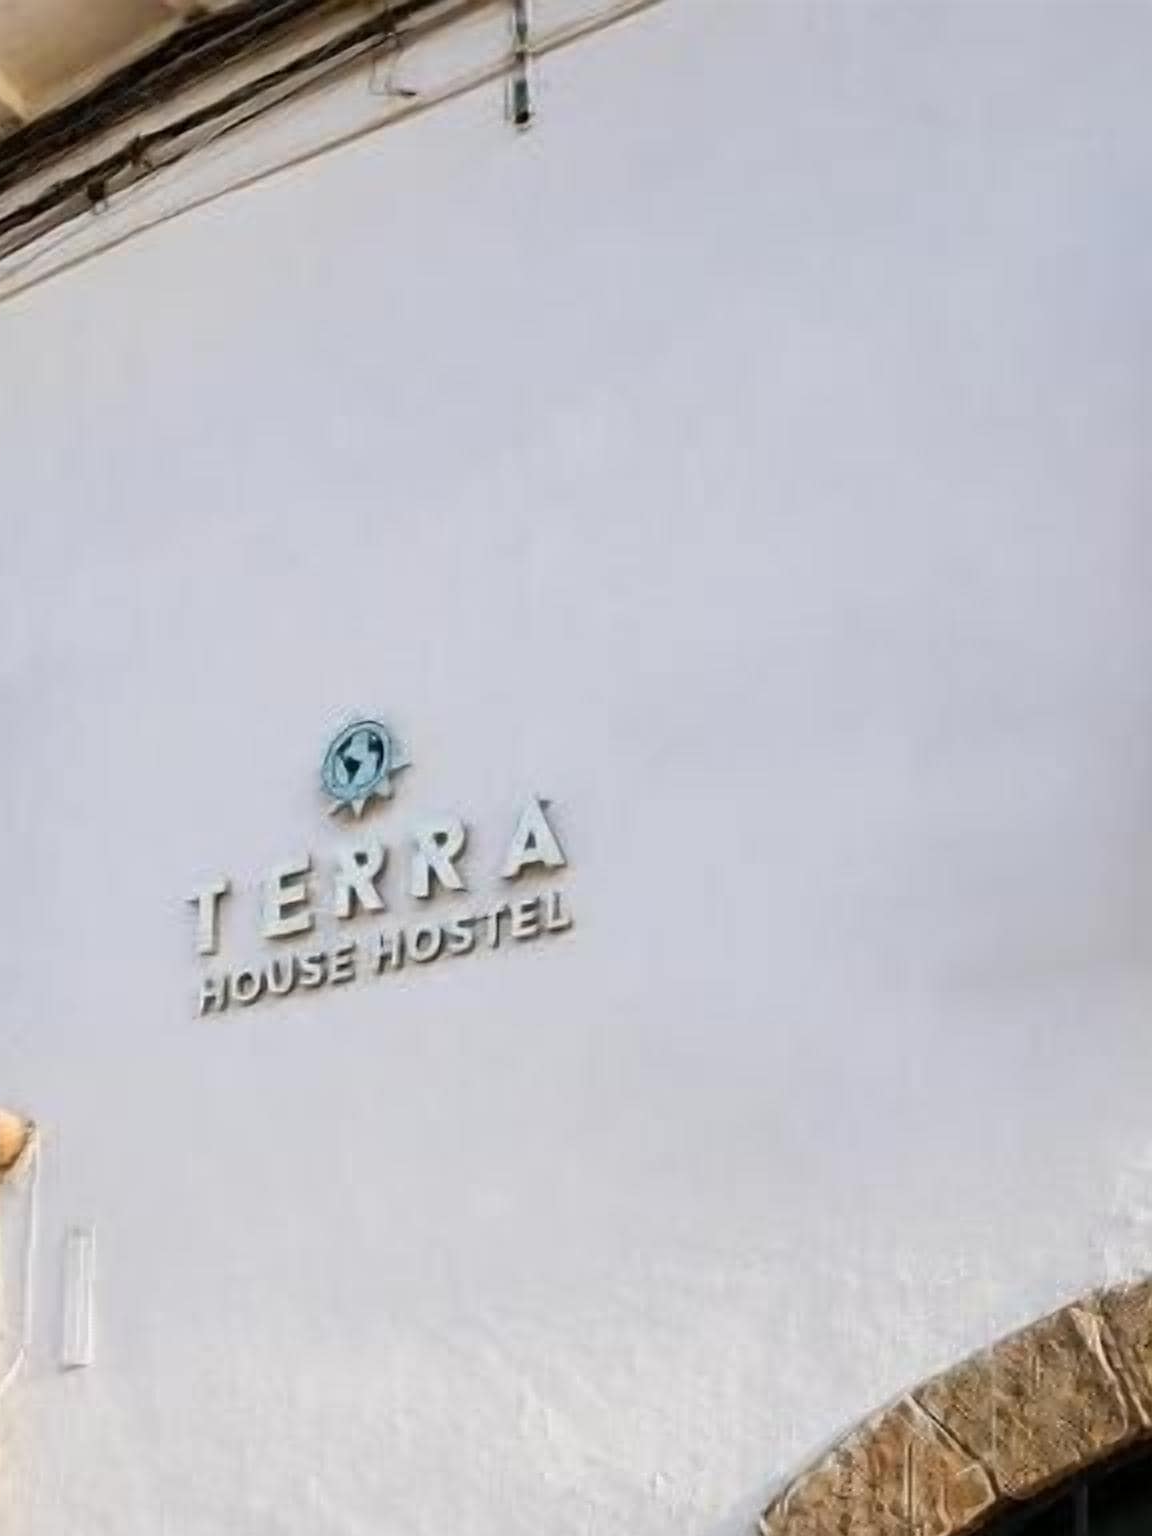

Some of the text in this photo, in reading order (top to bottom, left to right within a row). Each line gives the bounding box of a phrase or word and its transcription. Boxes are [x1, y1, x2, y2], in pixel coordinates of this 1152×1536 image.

[186, 795, 567, 956] TERRA
[198, 892, 573, 1015] HOUSE HOSTEL
